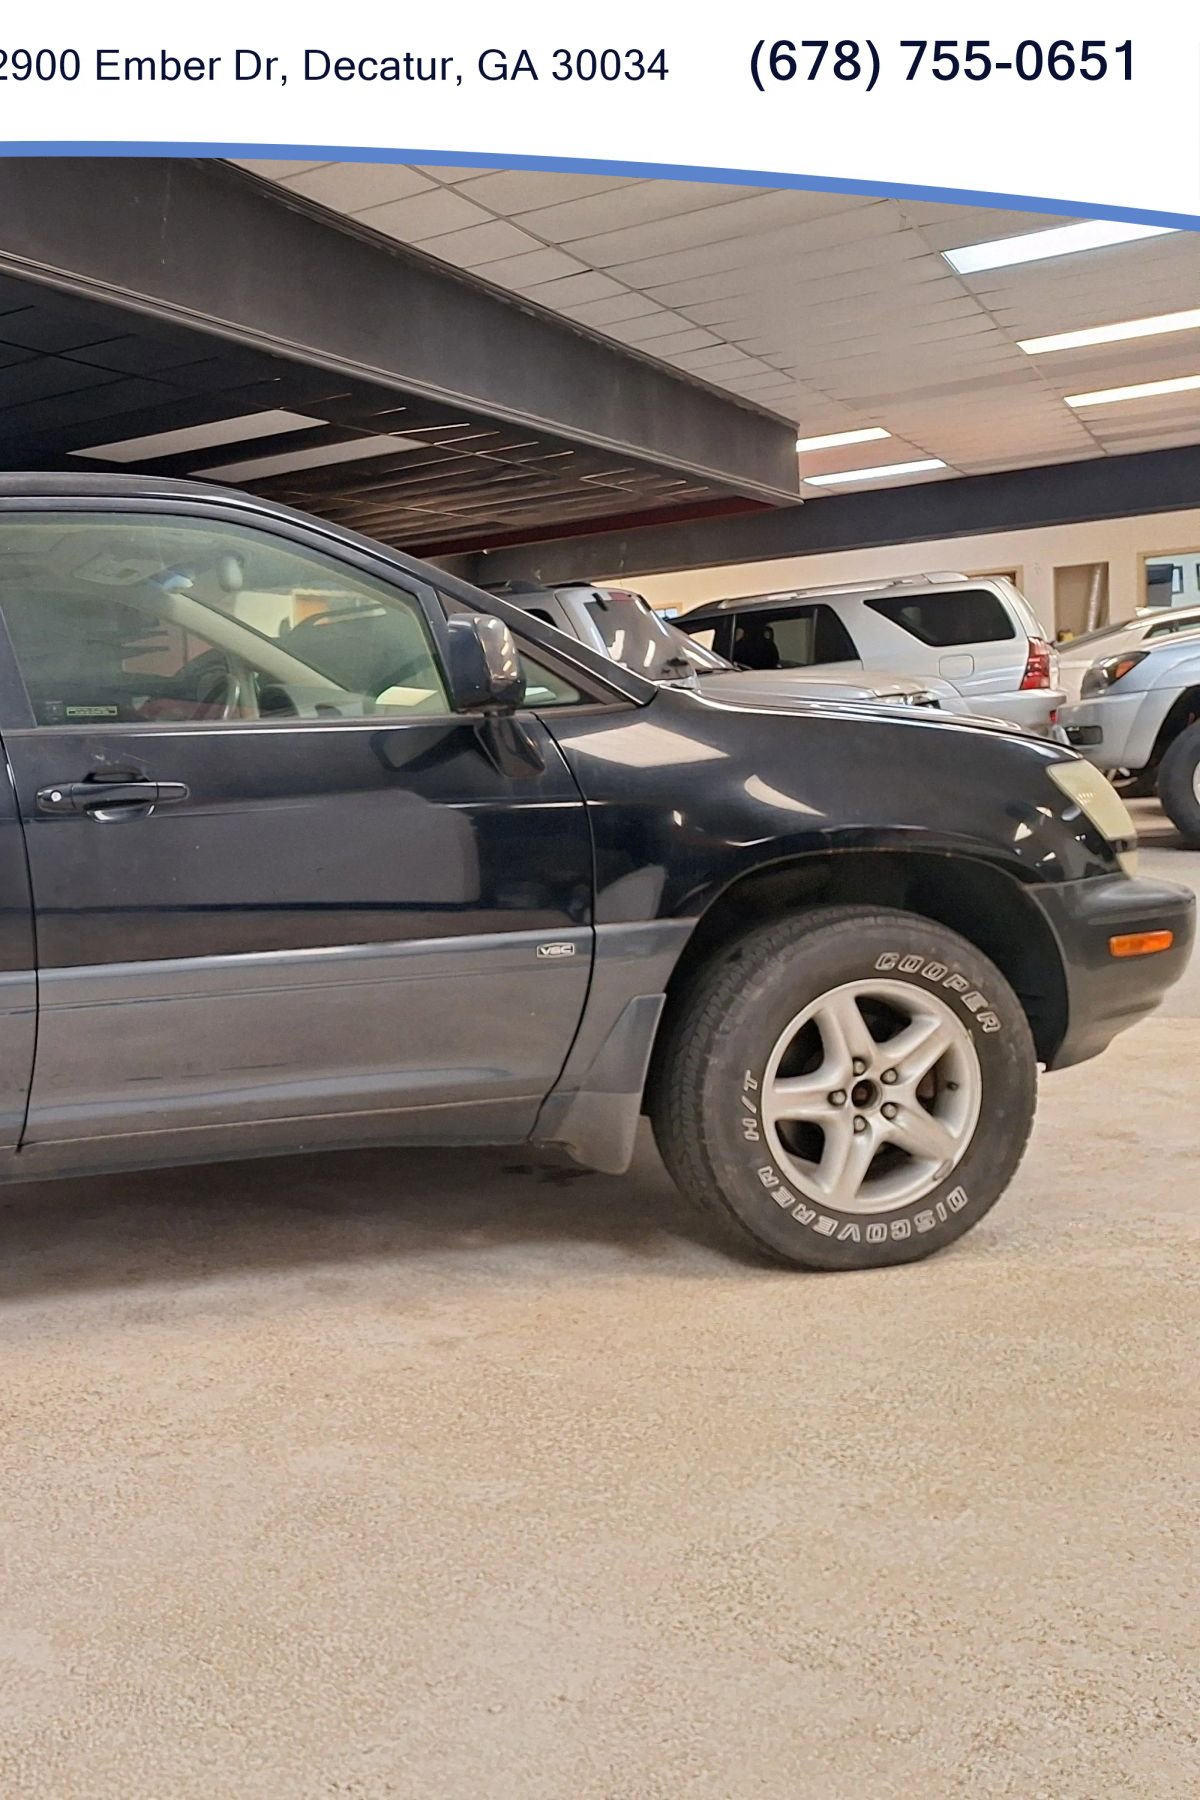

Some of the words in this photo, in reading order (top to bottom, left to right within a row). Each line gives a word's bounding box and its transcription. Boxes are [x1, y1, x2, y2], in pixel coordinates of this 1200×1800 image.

[875, 952, 1001, 1034] COOPER
[740, 1069, 760, 1142] H/T
[757, 1165, 969, 1243] DISCOVERER
